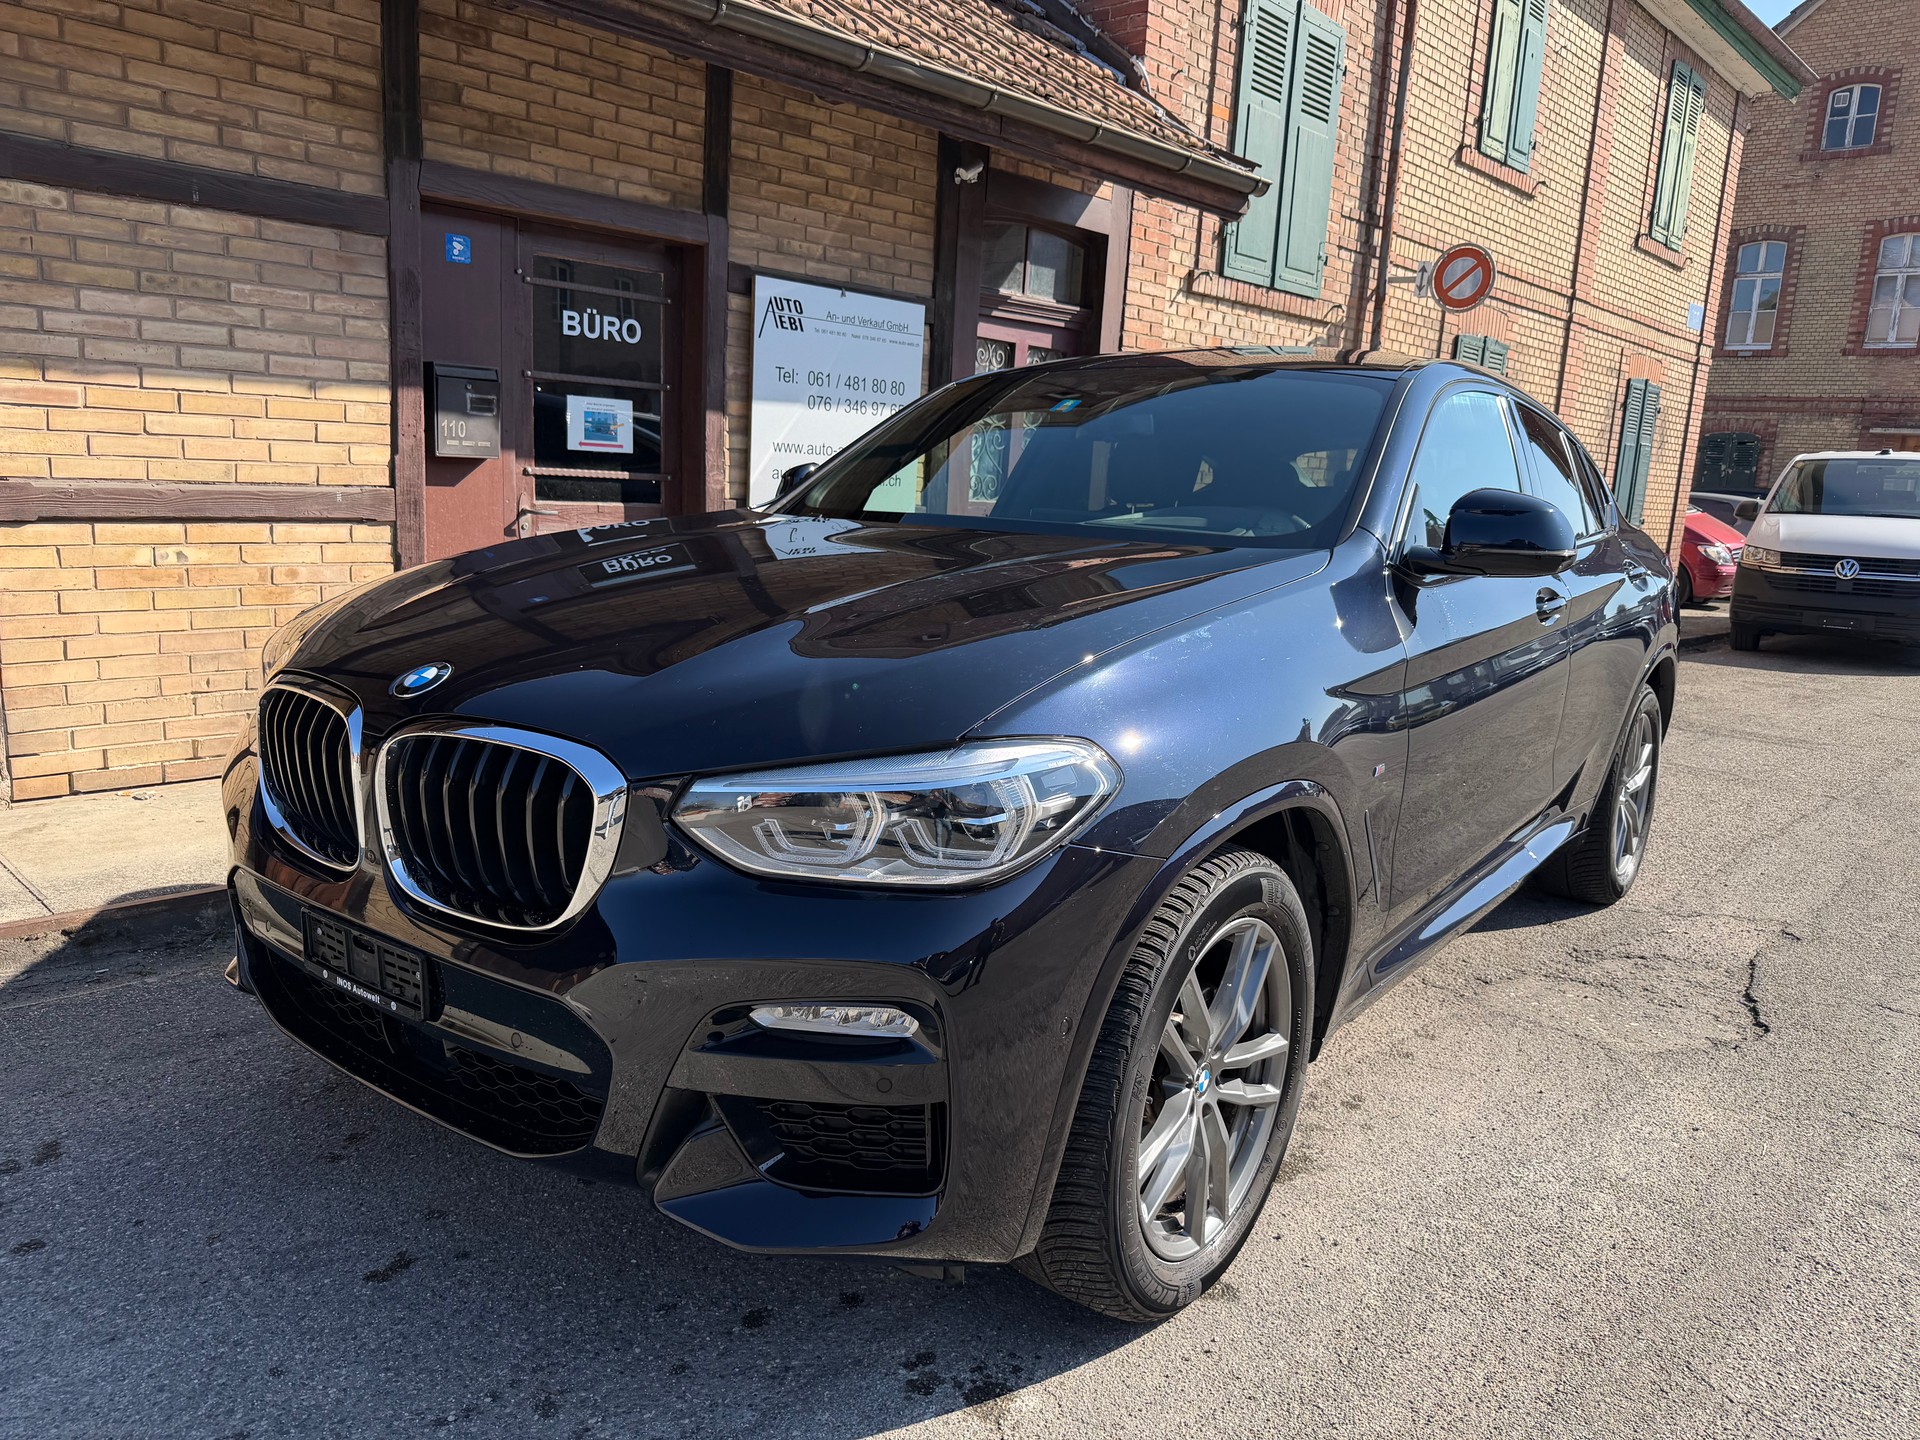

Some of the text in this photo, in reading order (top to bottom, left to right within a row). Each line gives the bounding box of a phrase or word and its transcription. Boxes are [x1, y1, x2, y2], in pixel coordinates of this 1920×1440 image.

[562, 308, 642, 344] BÜRO
[826, 311, 909, 332] An- und Verkauf GmbH
[775, 366, 905, 396] Tel: 061 / 481 80 80
[808, 395, 832, 412] 076
[835, 397, 841, 412] /
[844, 399, 867, 415] 346
[871, 402, 887, 416] 97
[441, 419, 466, 438] 110
[337, 976, 380, 1003] INOS Autowelt
